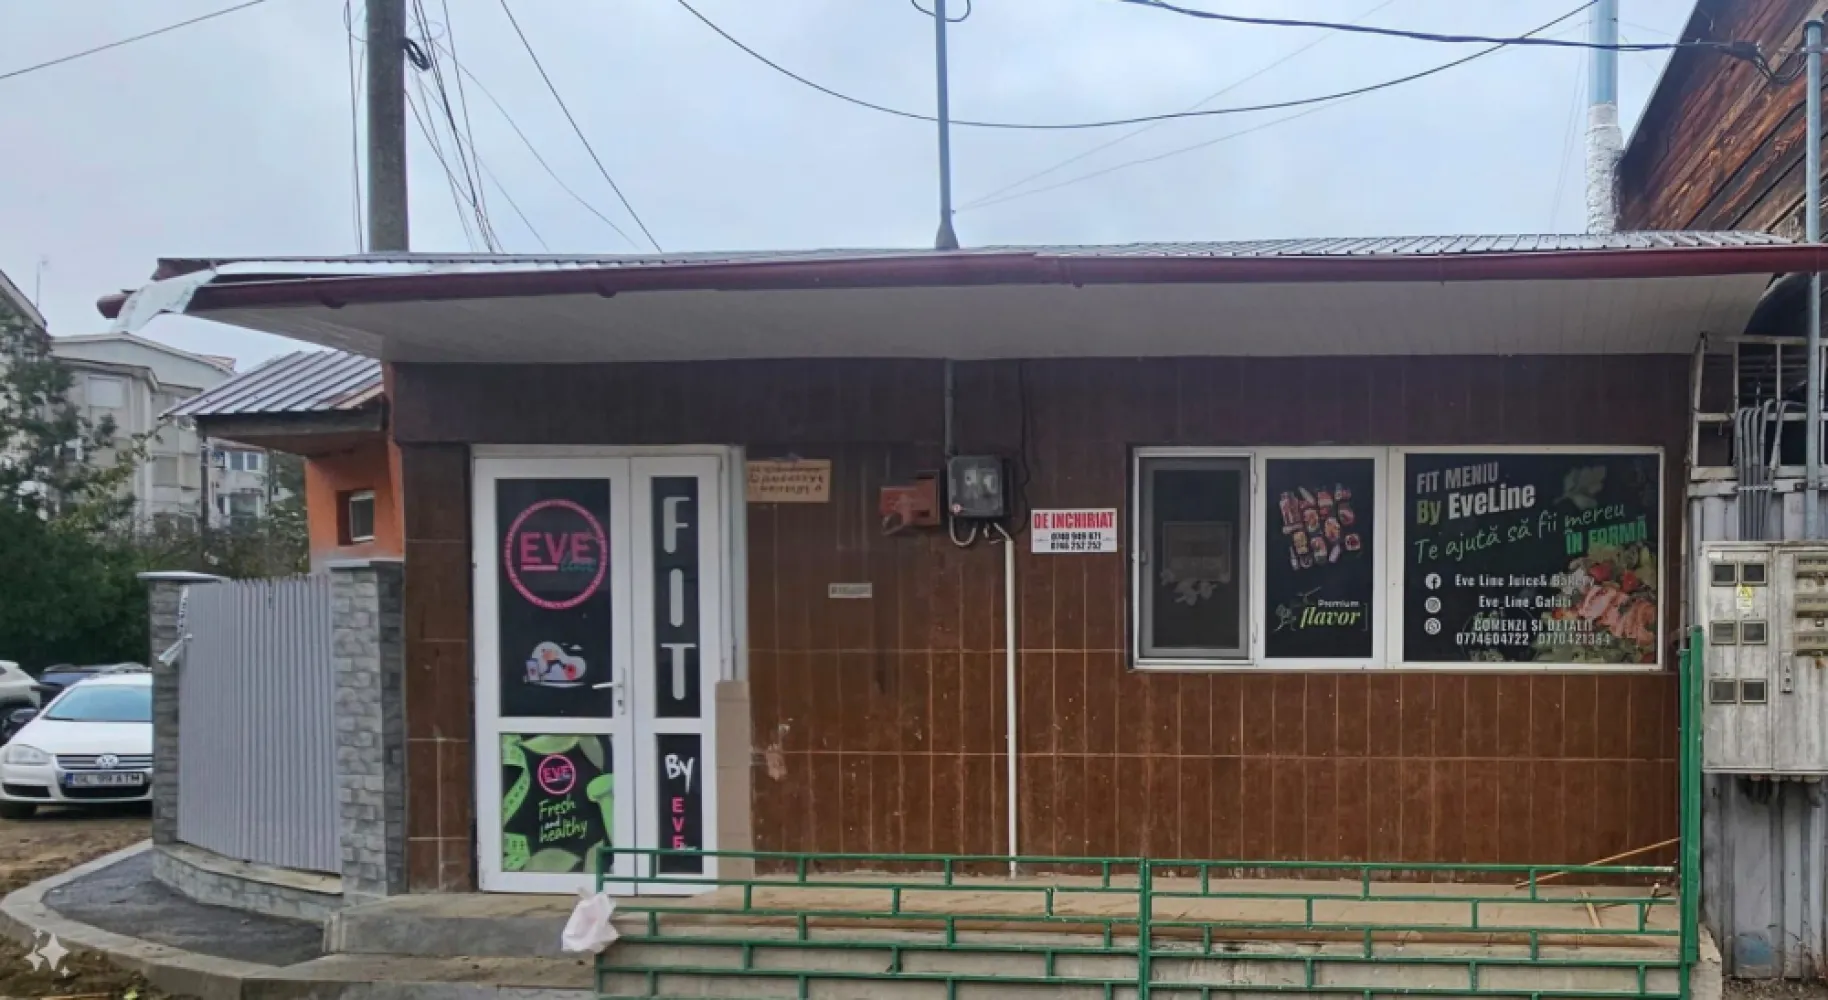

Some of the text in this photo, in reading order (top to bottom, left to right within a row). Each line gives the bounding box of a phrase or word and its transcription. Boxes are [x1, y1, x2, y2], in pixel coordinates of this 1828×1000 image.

[1416, 461, 1499, 494] FIT MENIU
[1416, 483, 1536, 526] By EveLine
[1034, 511, 1114, 528] DE INCHIRIAT
[1445, 524, 1501, 561] ajută
[1507, 518, 1532, 543] să
[1538, 510, 1557, 539] fii
[1564, 503, 1626, 530] mereu
[520, 531, 595, 564] EVE
[1455, 574, 1475, 587] Eve
[1479, 574, 1504, 587] Line
[1317, 599, 1360, 608] Premium
[1300, 606, 1361, 629] flavor
[1474, 619, 1527, 632] COMENZI
[665, 754, 694, 794] By
[539, 793, 576, 821] Fresh
[539, 816, 588, 843] healthy
